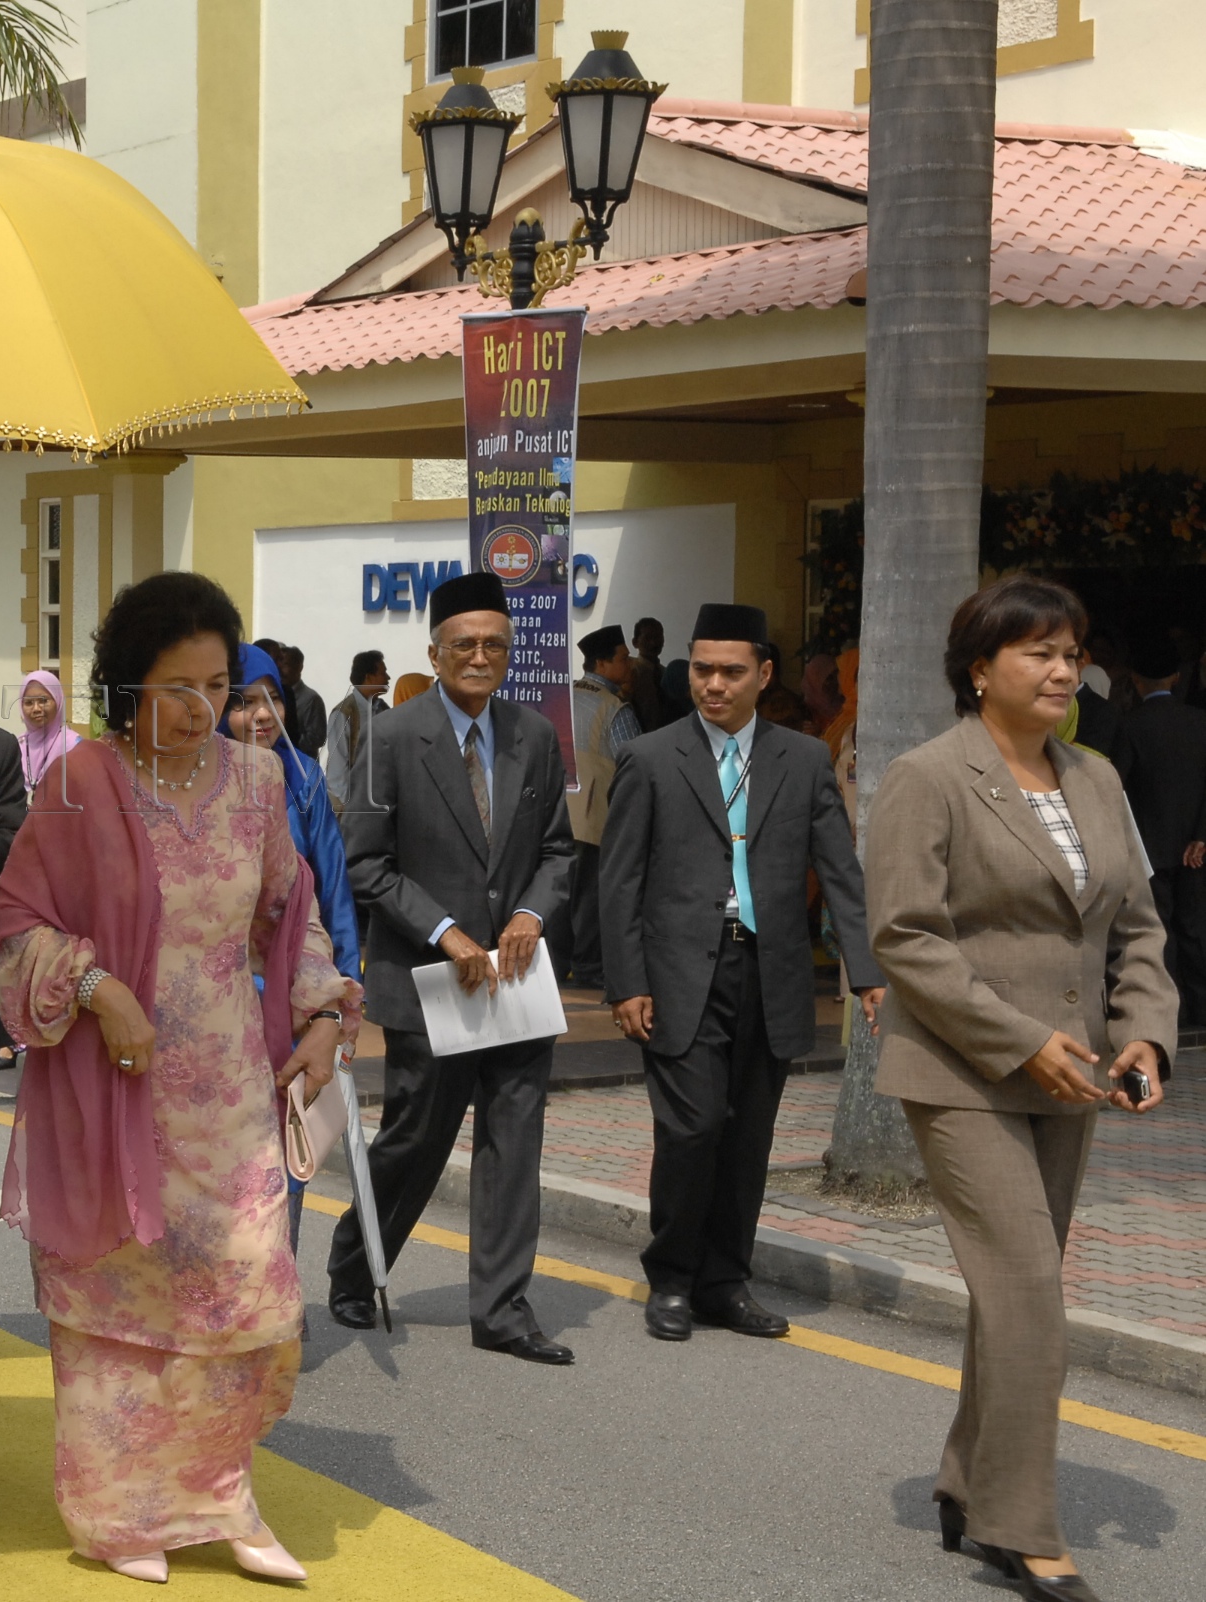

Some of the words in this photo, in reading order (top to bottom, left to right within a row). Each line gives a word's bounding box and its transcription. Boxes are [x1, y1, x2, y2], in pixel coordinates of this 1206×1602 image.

[484, 331, 523, 374] Hari
[533, 331, 566, 371] ICT
[515, 430, 552, 453] Pusat
[530, 595, 557, 610] 2007
[534, 633, 566, 648] 1428H
[514, 650, 544, 668] SITC,
[507, 669, 569, 684] Pendidikan
[515, 687, 542, 702] Idris
